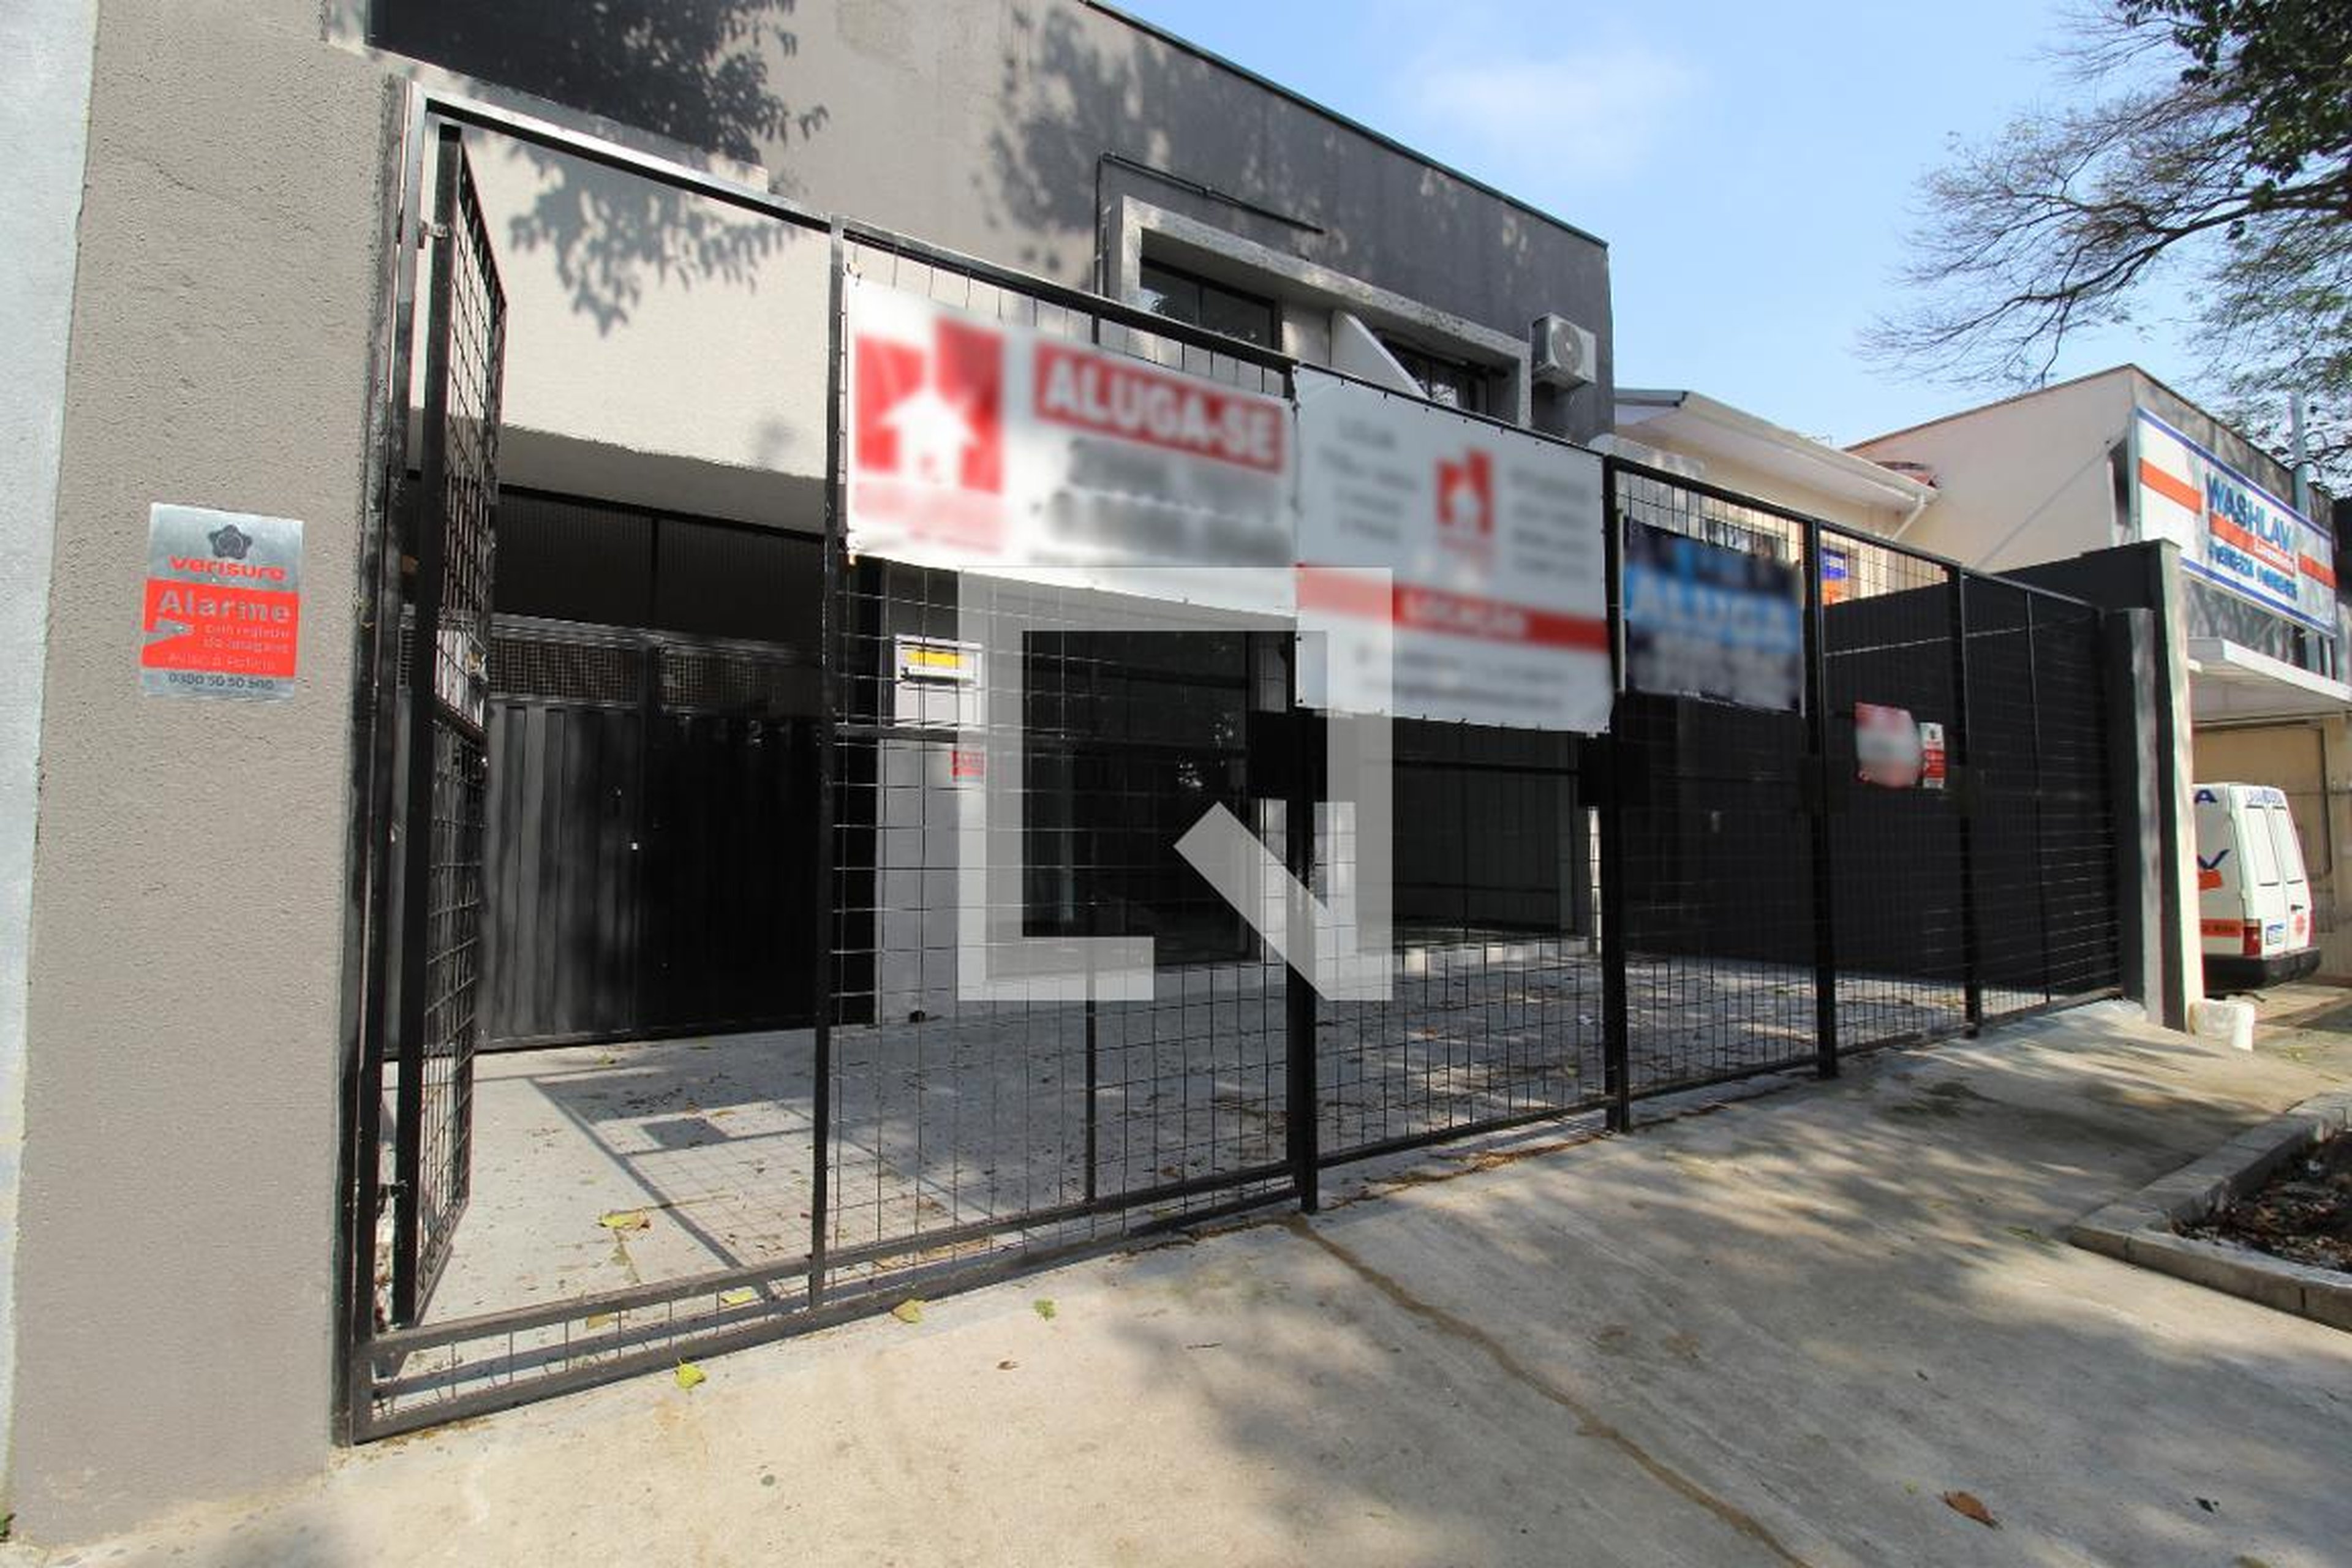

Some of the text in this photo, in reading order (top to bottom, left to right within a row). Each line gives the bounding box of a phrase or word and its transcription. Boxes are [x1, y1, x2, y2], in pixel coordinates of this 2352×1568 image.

[1042, 359, 1276, 462] ALUGA-SE
[2206, 473, 2291, 551] WASHLAV
[168, 555, 288, 582] verisure
[159, 589, 292, 624] Alarme
